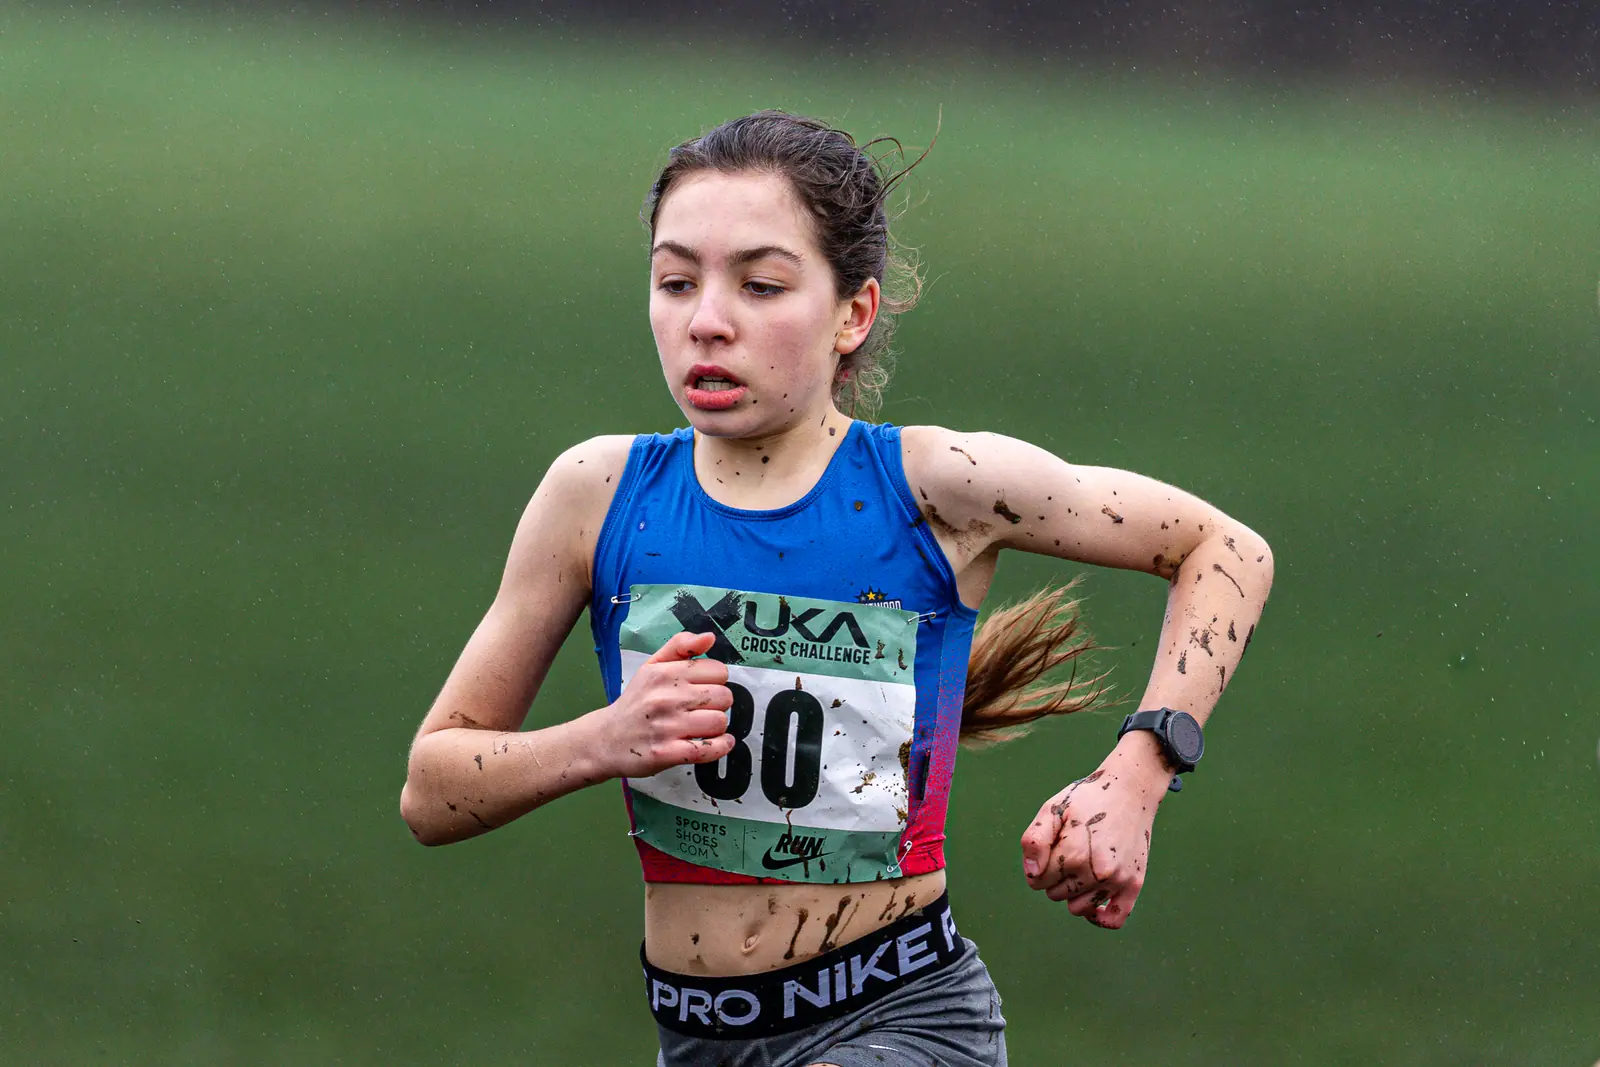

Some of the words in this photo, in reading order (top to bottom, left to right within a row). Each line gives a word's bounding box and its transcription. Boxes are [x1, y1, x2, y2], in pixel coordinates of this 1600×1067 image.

[744, 600, 871, 649] UKA
[741, 635, 787, 655] CROSS
[790, 641, 871, 666] CHALLENGE
[675, 815, 727, 836] SPORTS
[675, 829, 718, 848] SHOES
[774, 833, 824, 857] RUN
[652, 979, 762, 1026] PRO
[783, 921, 938, 1019] NIKE
